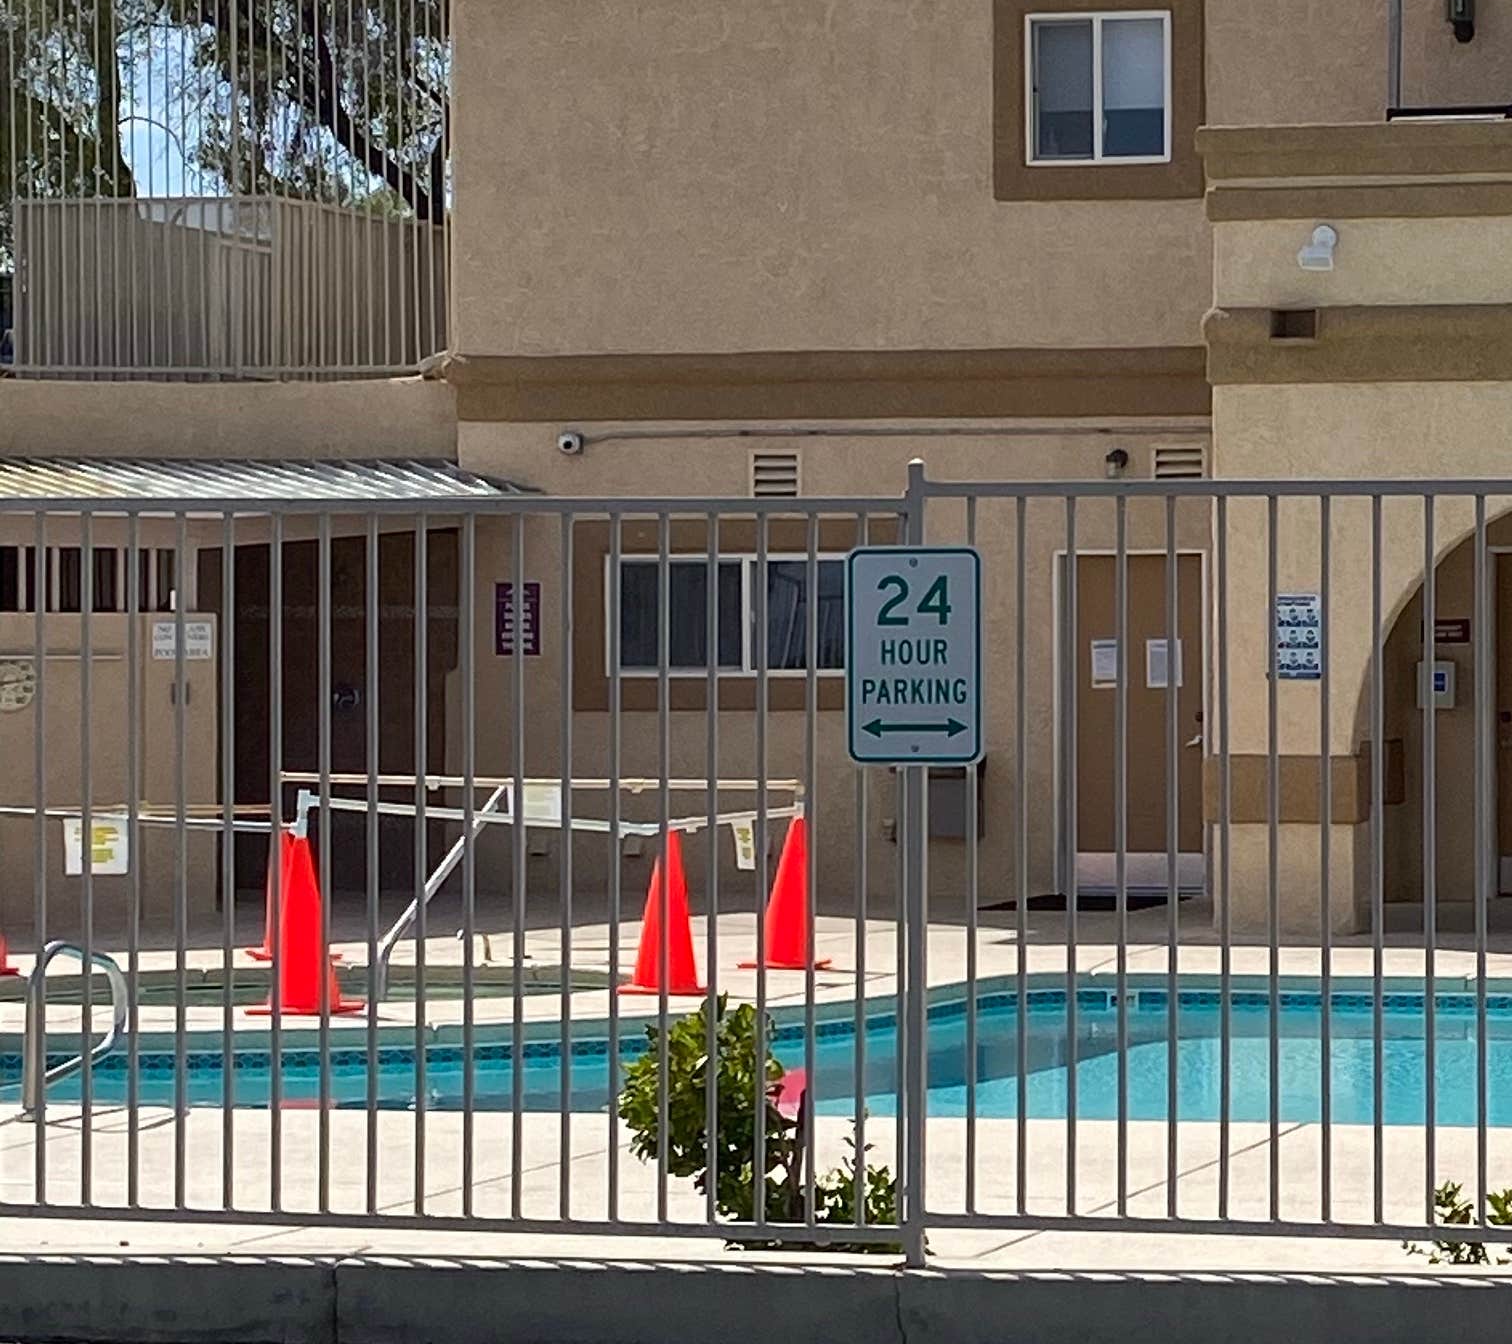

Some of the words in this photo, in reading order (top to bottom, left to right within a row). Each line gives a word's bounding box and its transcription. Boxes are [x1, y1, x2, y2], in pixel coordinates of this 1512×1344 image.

[877, 575, 951, 626] 24
[153, 648, 178, 658] POO
[881, 639, 948, 665] HOUR
[862, 679, 967, 705] PARKING
